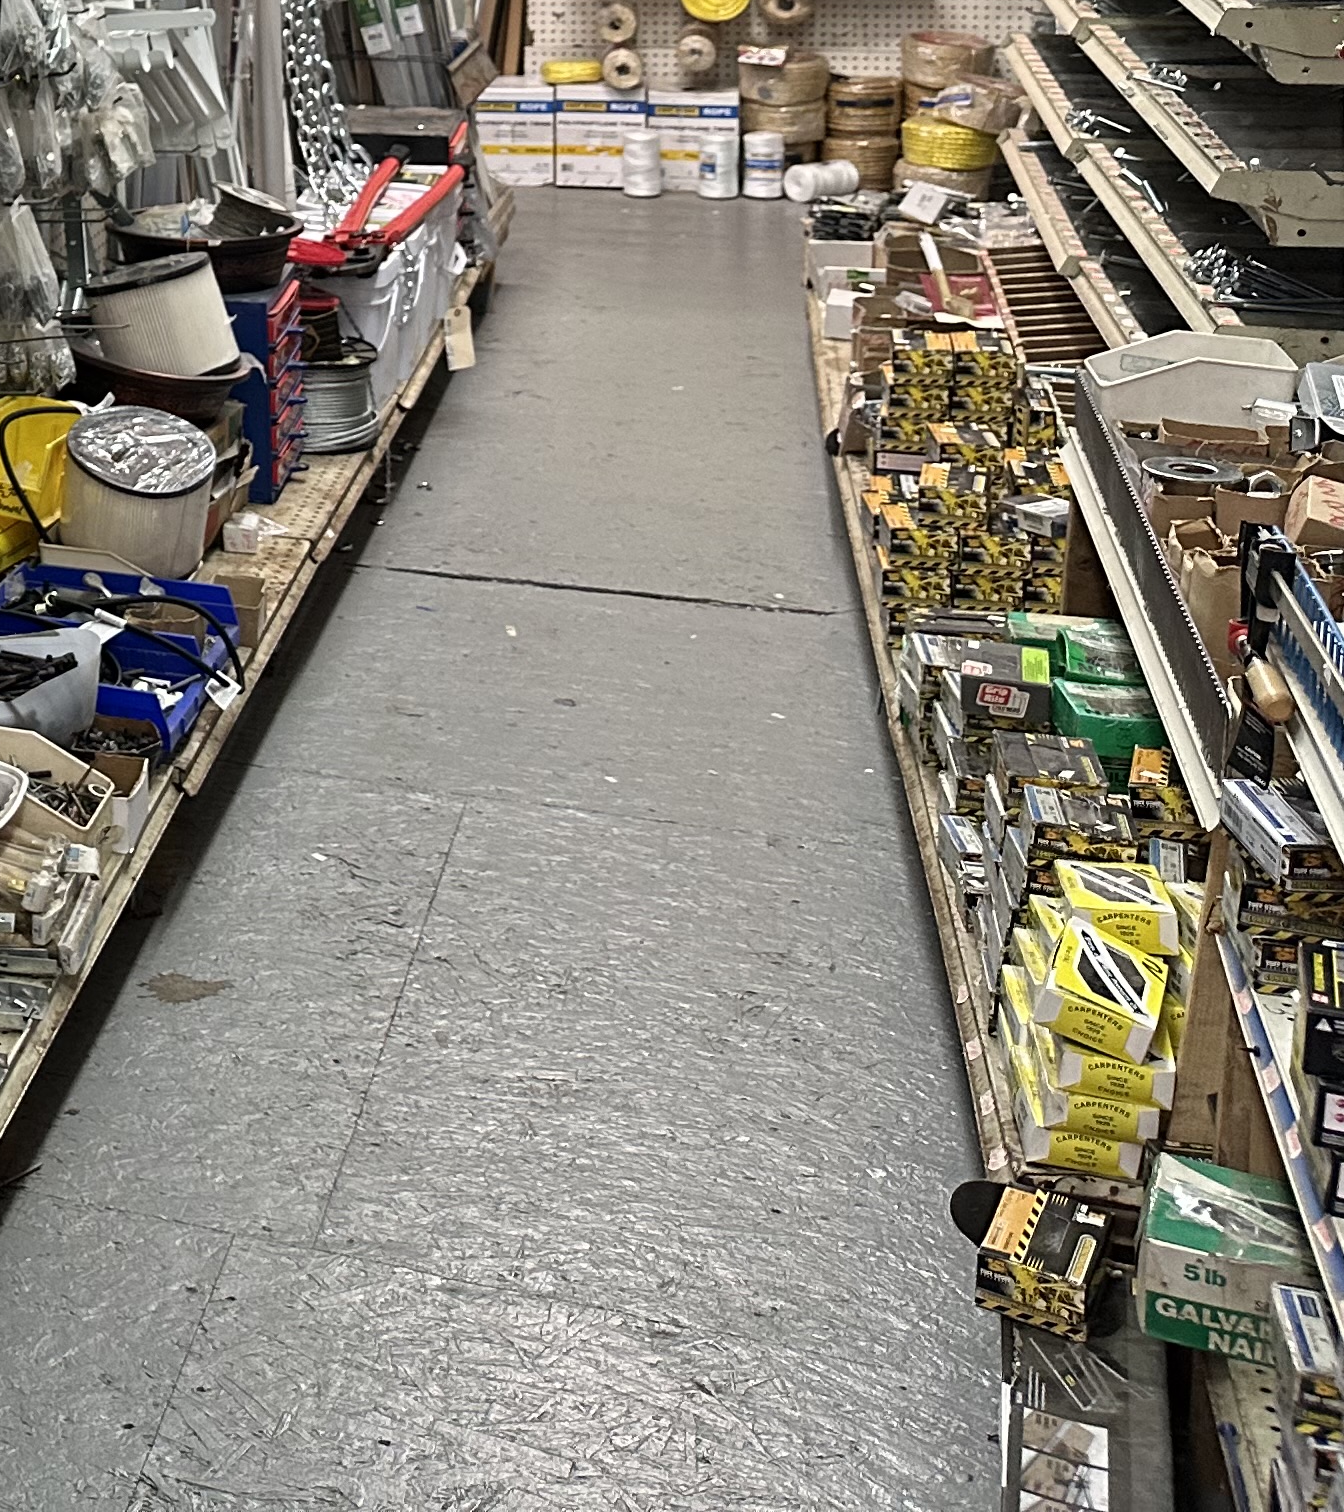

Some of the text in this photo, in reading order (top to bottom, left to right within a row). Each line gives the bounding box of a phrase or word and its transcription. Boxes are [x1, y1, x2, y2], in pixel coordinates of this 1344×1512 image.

[519, 103, 548, 112] ROPE
[702, 106, 732, 117] ROPE
[1096, 911, 1151, 926] CARPENTERS
[1067, 1005, 1124, 1032] CARPENTERS
[1087, 1062, 1145, 1081] CARPENTERS
[1074, 1100, 1131, 1120] CARPENTERS
[1184, 1264, 1228, 1287] 5 lb
